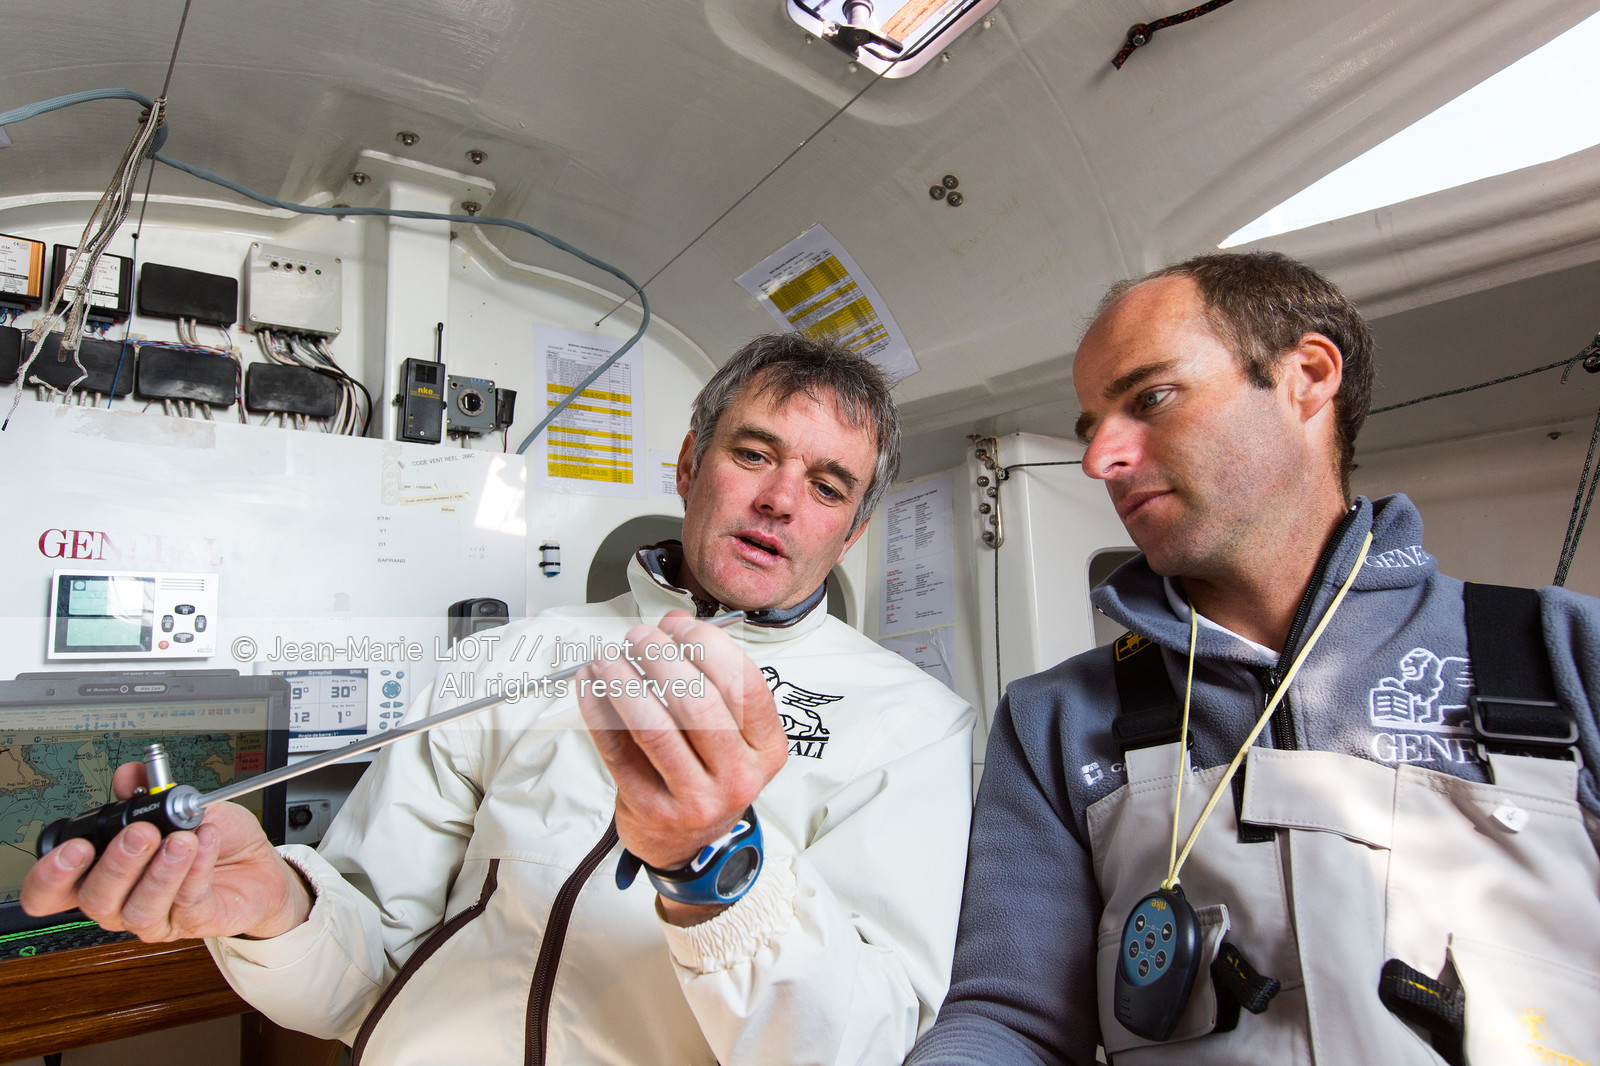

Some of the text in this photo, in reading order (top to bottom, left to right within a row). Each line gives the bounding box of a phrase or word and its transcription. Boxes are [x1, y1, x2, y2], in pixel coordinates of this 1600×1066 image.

[417, 386, 434, 395] nke
[411, 459, 429, 467] CODE
[429, 457, 443, 465] VENT
[788, 741, 828, 759] ALI
[1152, 899, 1168, 912] nke
